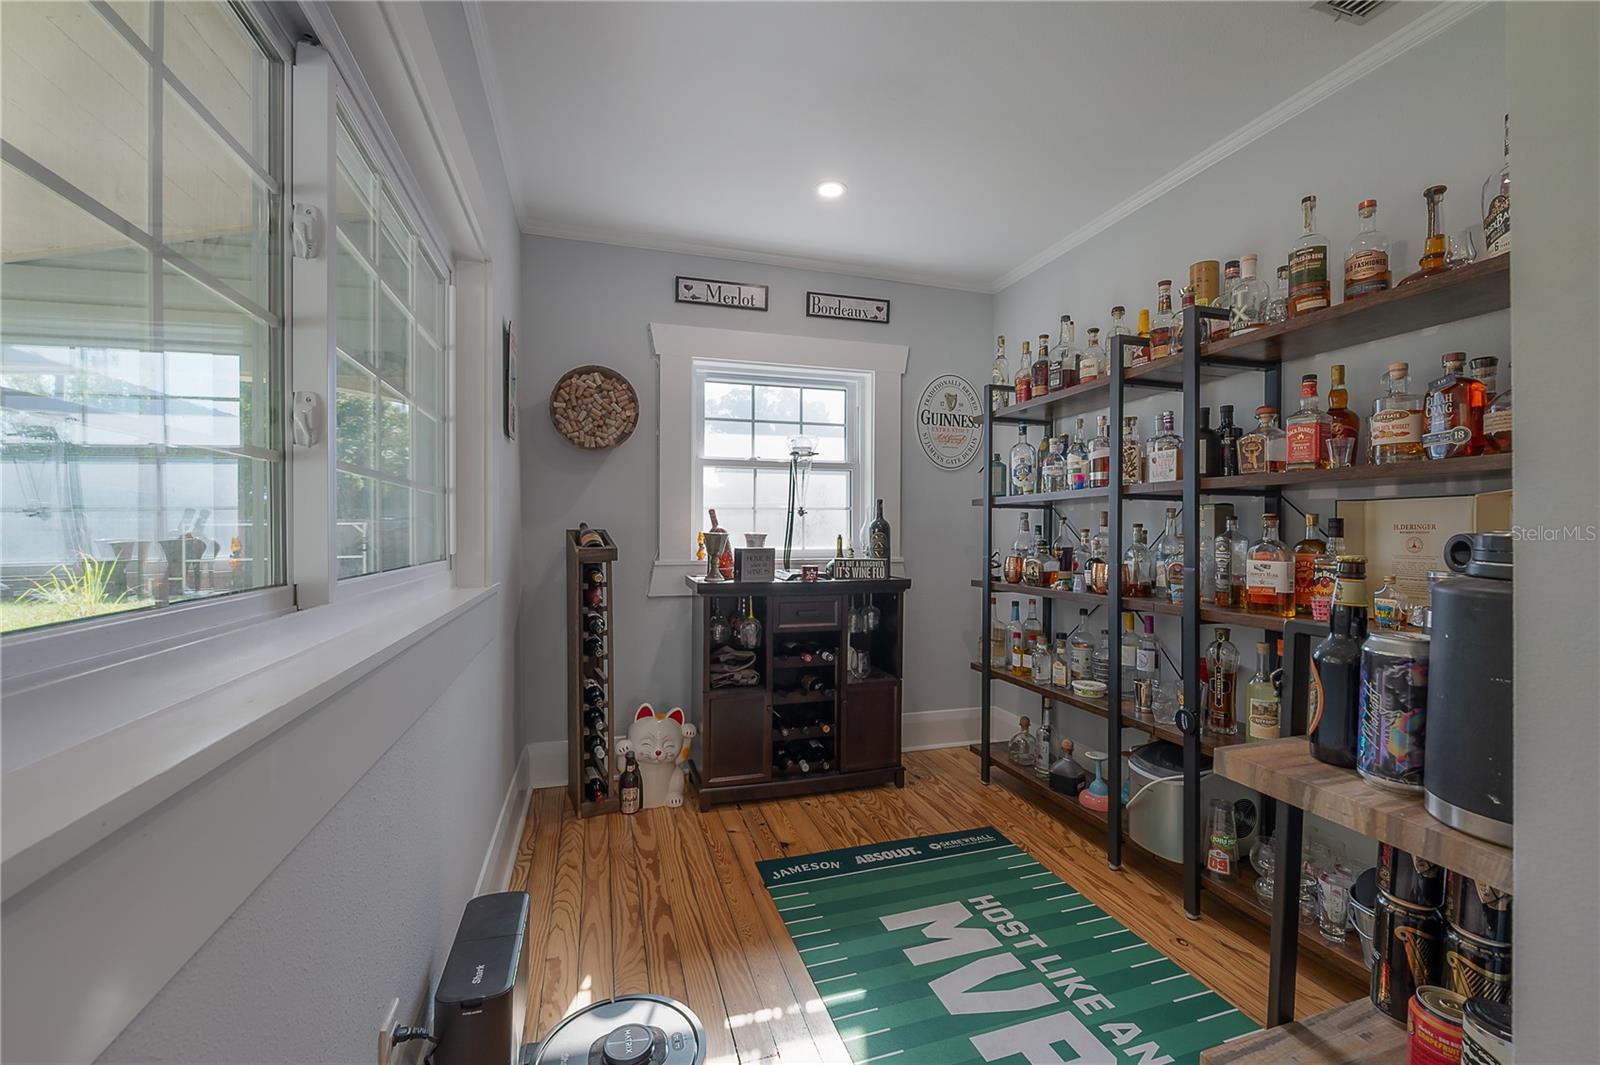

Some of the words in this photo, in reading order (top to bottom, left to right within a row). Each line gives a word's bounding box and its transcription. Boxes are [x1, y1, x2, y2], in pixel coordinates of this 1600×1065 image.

[1353, 258, 1387, 270] FASHIONED
[705, 283, 756, 307] Merlot
[811, 295, 869, 319] Bordeaux
[924, 379, 962, 407] TRADITIONALLY
[962, 385, 978, 411] BREWED
[1425, 402, 1454, 418] CRAIG
[1454, 430, 1465, 439] 18
[836, 567, 850, 578] IT'S
[851, 567, 871, 579] WINE
[872, 567, 885, 579] FLU
[1362, 679, 1382, 750] Midnight
[940, 833, 994, 848] SKREWBALL
[773, 860, 840, 880] JAMESON
[471, 964, 486, 985] Shark
[879, 901, 1118, 1065] MVP
[968, 894, 1048, 949] HOST
[1031, 954, 1116, 1016] LIKE
[1099, 1022, 1175, 1065] AN
[624, 1029, 633, 1055] MATRIX
[1417, 1030, 1461, 1056] GRAPEFRUIT
